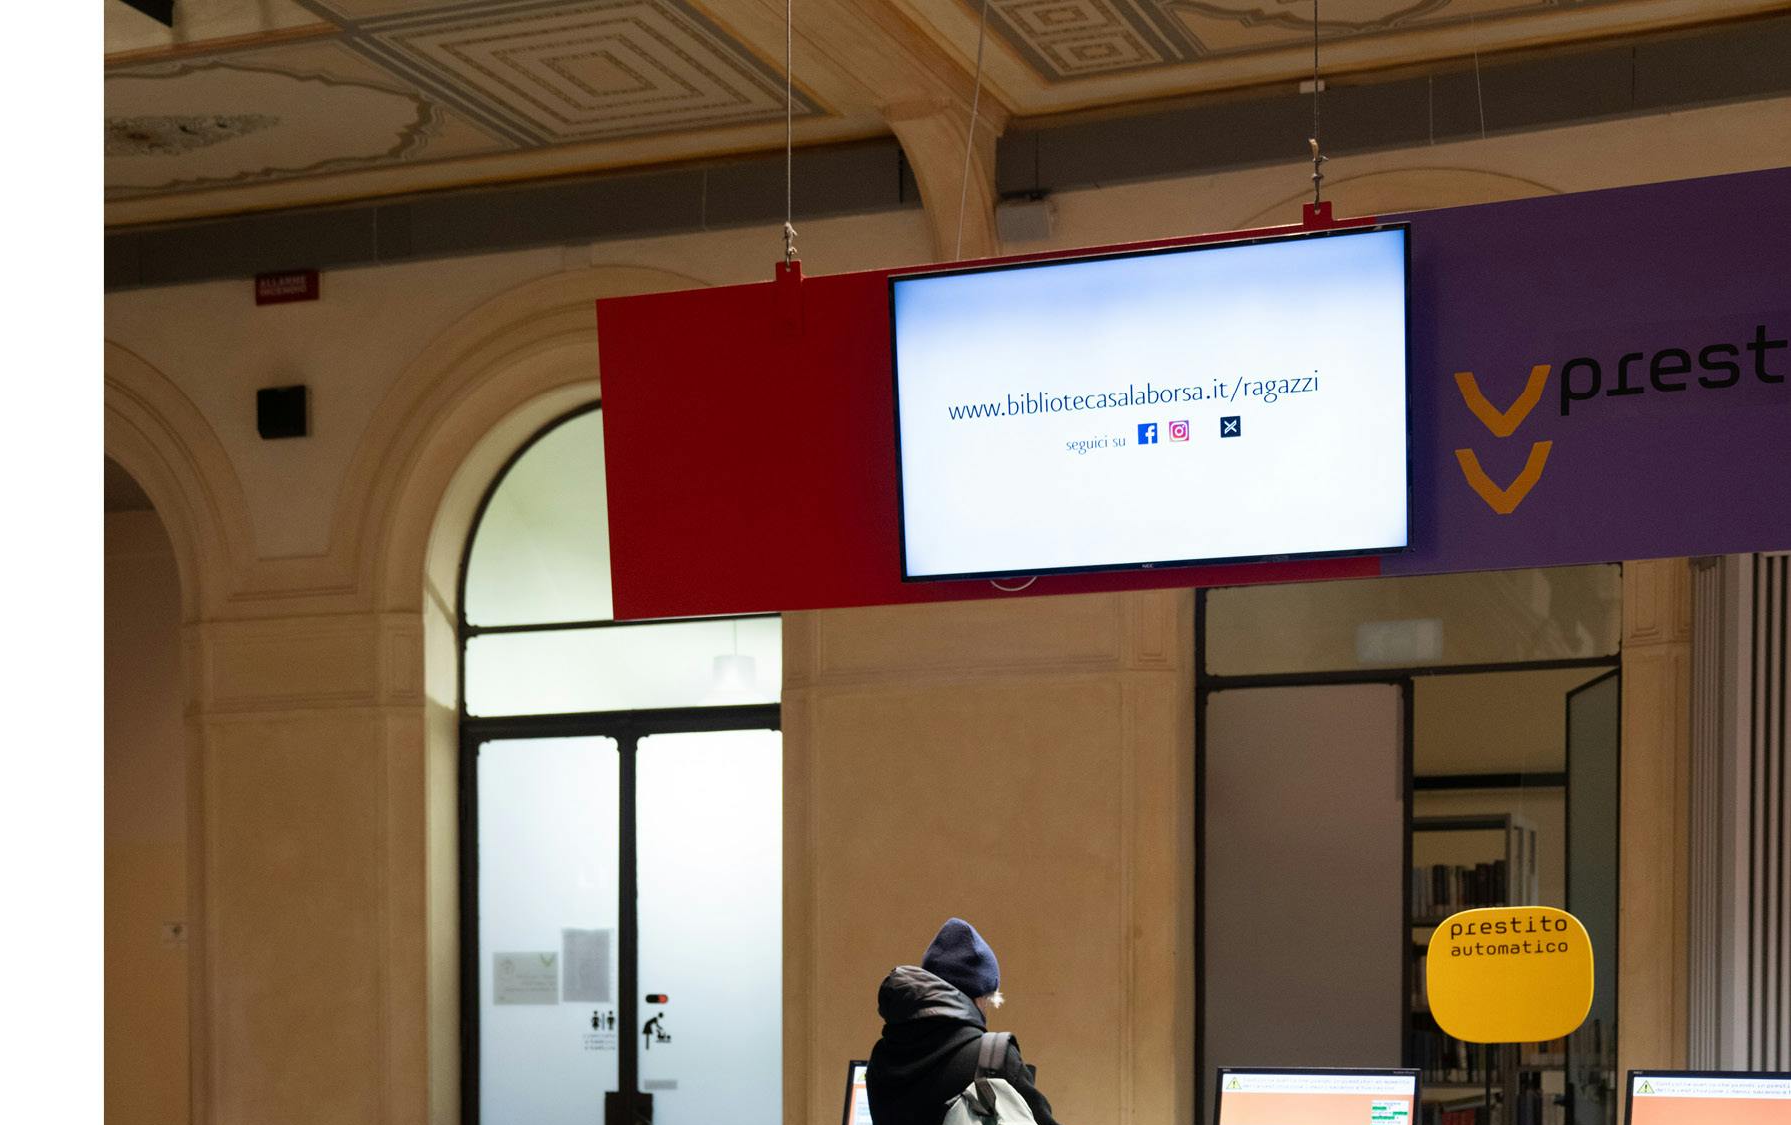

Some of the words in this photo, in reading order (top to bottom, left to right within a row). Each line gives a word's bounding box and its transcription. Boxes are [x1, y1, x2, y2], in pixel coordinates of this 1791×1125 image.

[1560, 324, 1789, 417] prest
[947, 369, 1319, 421] www.bibliotecasalaborsa.it/ragazzi
[1066, 434, 1108, 455] seguici
[1112, 435, 1126, 448] su
[1450, 915, 1568, 940] prestito
[1450, 939, 1569, 957] automatico
